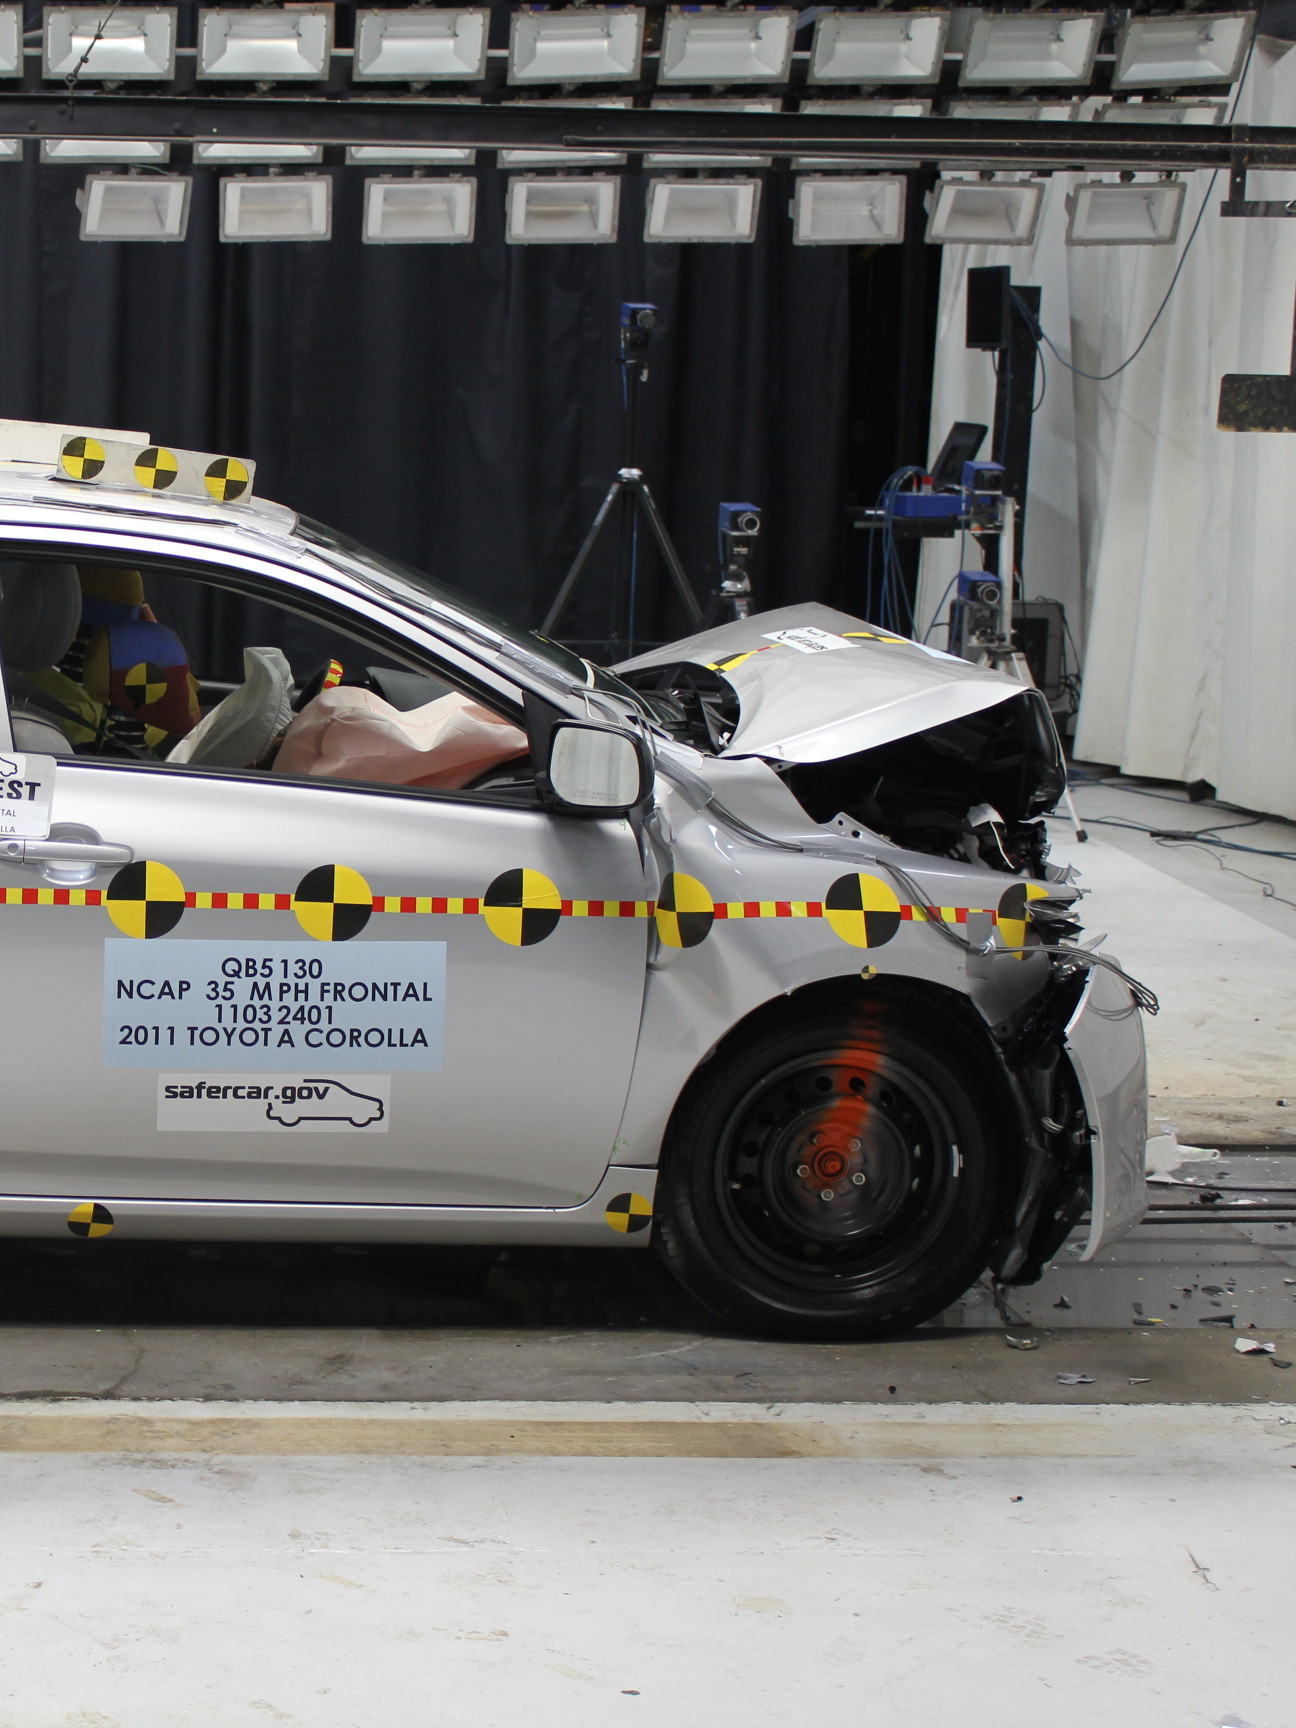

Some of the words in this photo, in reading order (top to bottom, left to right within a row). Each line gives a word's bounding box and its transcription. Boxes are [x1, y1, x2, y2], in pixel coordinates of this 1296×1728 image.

[221, 957, 323, 979] QB5130
[116, 979, 191, 1000] NCAP
[205, 980, 235, 1001] 35
[249, 982, 309, 1002] MPH
[319, 982, 433, 1002] FRONTAL
[214, 1004, 334, 1025] 11032401
[118, 1025, 175, 1046] 2011
[187, 1026, 296, 1048] TOYOTA
[304, 1027, 429, 1048] COROLLA
[164, 1081, 331, 1104] safercar.gov
